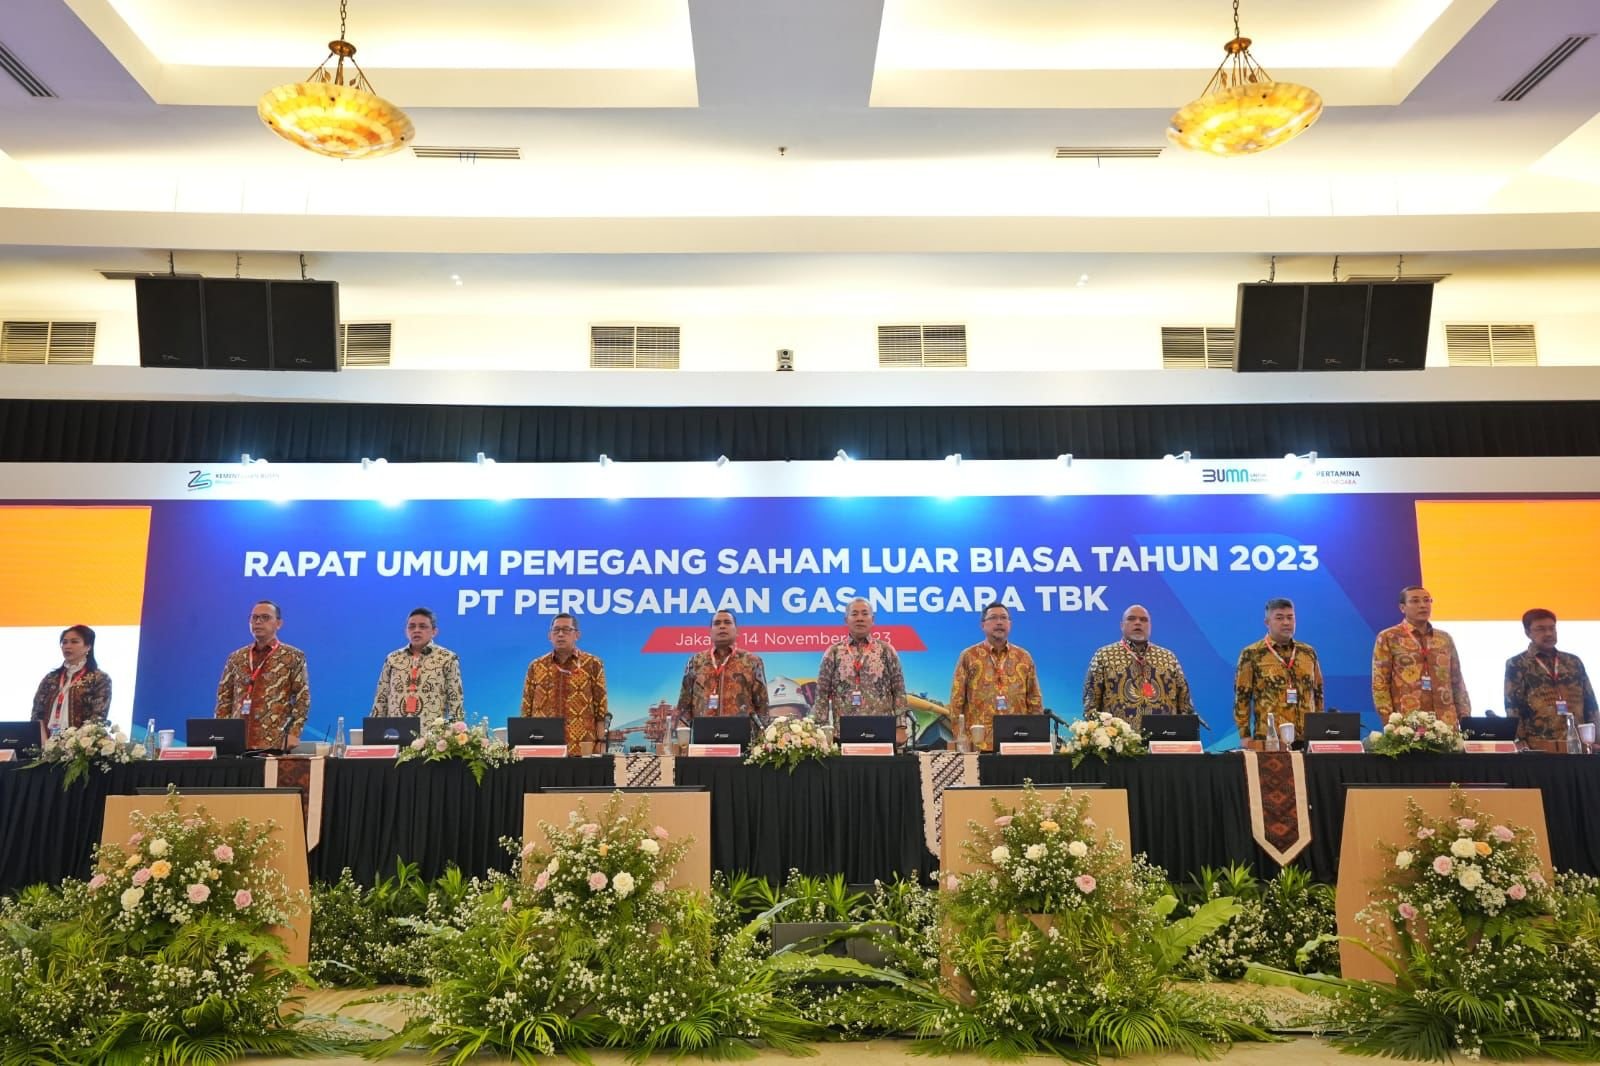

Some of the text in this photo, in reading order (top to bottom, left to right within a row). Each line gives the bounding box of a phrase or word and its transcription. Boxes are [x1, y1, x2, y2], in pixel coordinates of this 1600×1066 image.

[1202, 468, 1248, 483] BUMN
[244, 544, 1320, 577] RAPAT UMUM PEMEGANG SAHAM LUAR BIASA TAHUN 2023
[458, 585, 1109, 615] PT PERUSAHAAN GAS NEGARA TBK
[742, 632, 759, 646] 14
[764, 631, 847, 646] November
